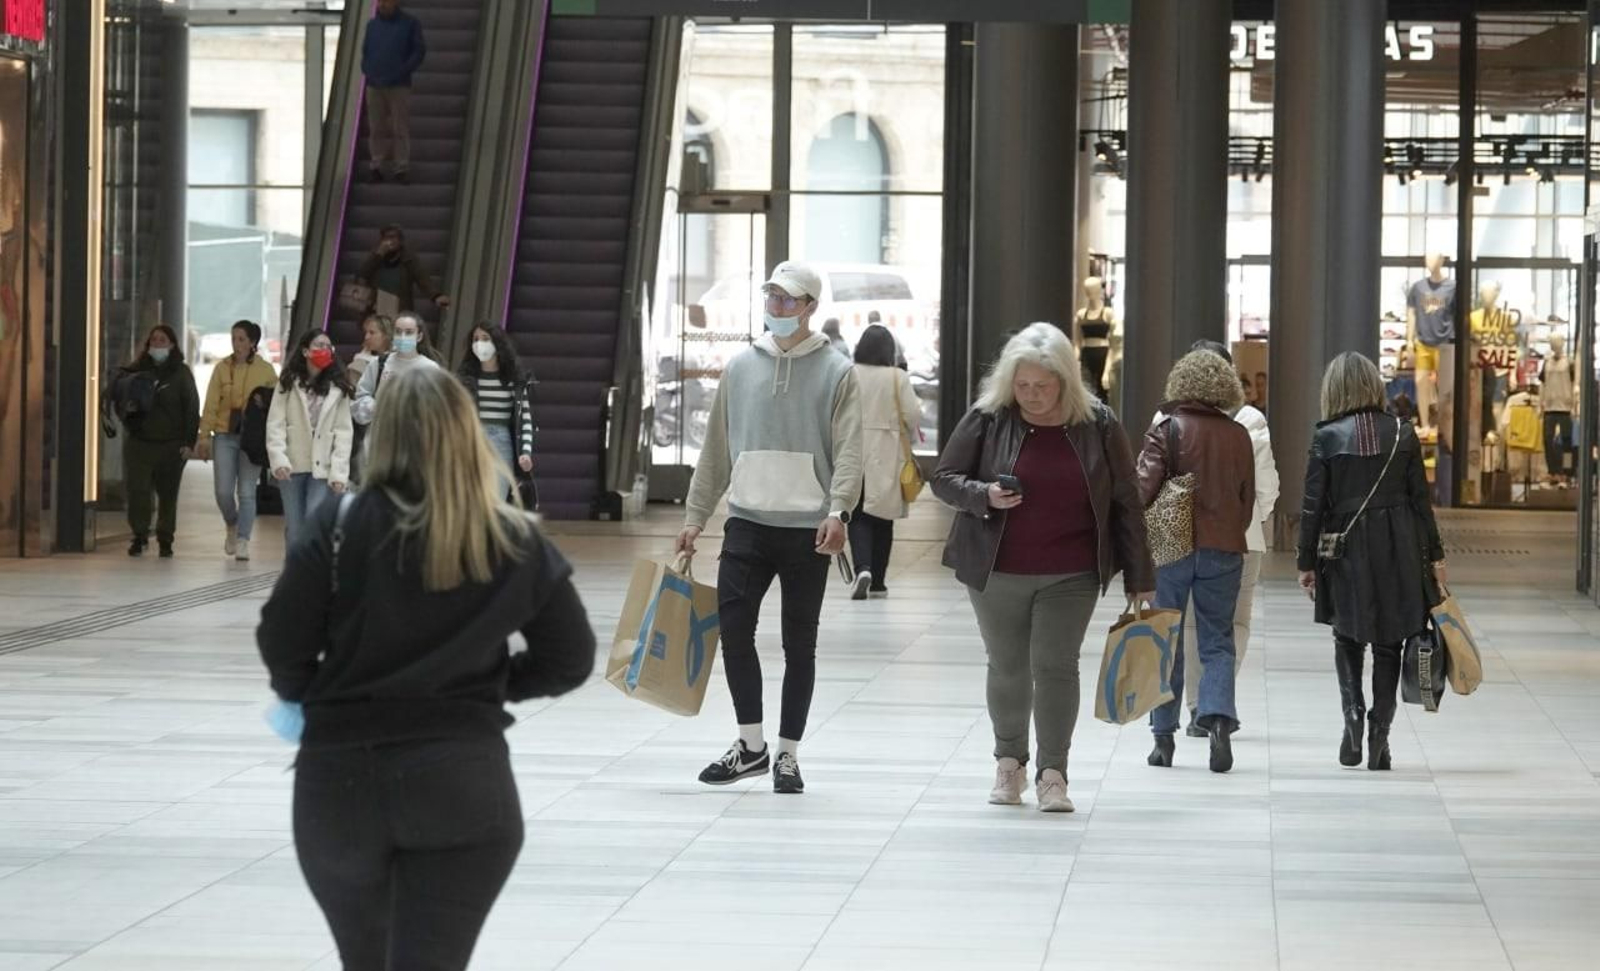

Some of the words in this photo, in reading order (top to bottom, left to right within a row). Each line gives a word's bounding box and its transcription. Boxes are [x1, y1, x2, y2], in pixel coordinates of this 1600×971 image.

[1230, 25, 1434, 61] DEAS
[1482, 300, 1522, 332] MID
[1478, 349, 1517, 370] SALE
